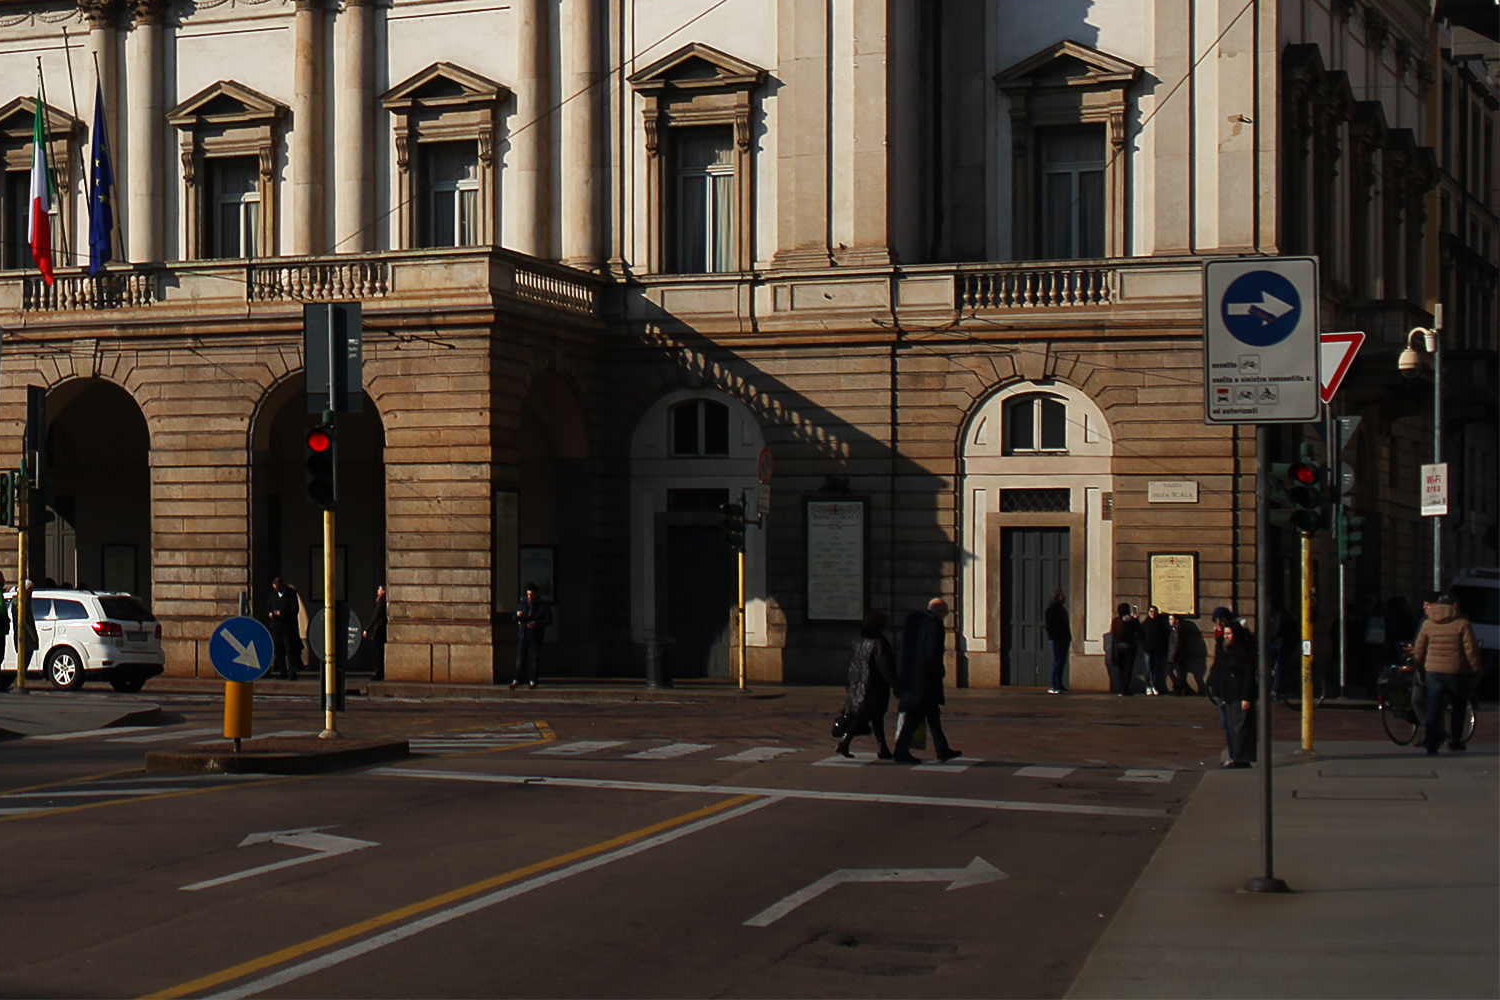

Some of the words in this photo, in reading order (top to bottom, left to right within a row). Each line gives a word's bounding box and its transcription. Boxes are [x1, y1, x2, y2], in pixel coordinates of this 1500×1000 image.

[1240, 375, 1267, 383] sinistra
[1426, 474, 1442, 485] Wi-Fi
[1426, 485, 1441, 493] area
